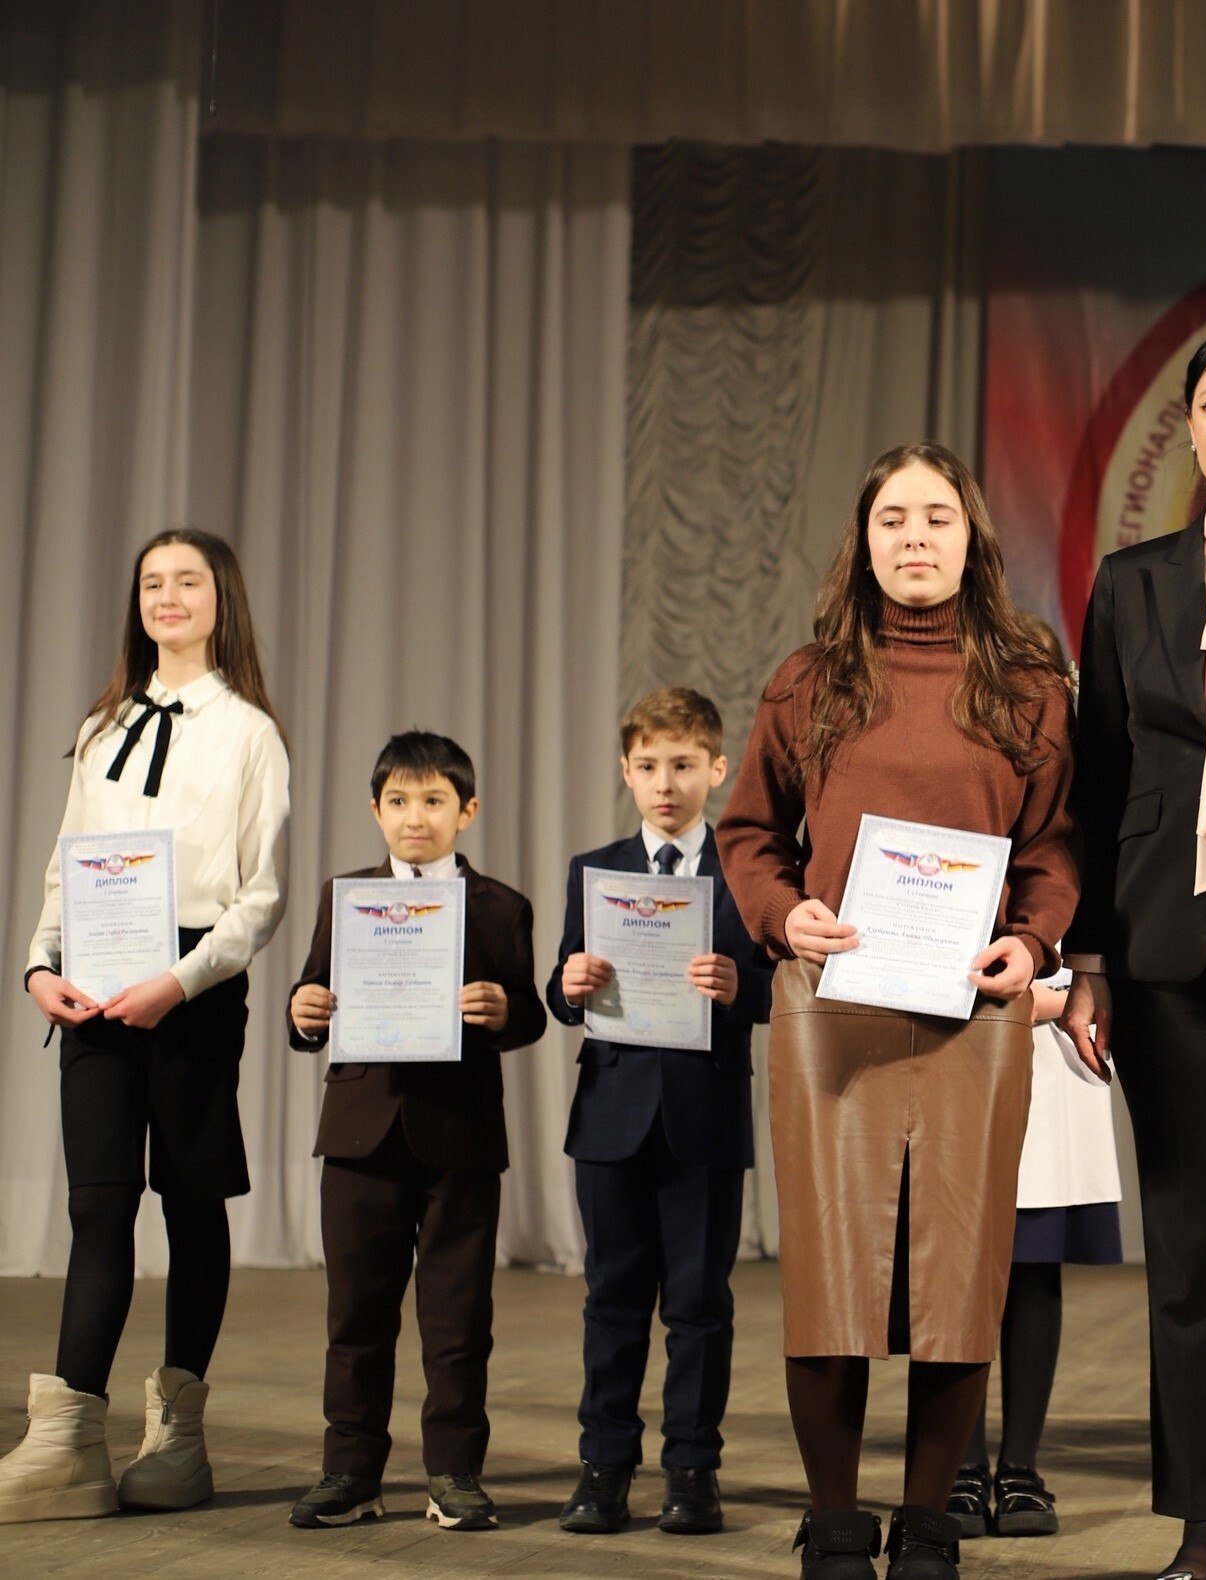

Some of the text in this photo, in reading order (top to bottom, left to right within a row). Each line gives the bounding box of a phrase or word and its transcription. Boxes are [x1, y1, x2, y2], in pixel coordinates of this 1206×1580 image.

[95, 876, 138, 888] ДИПЛОМ
[896, 874, 953, 891] ДИПЛОМ
[622, 917, 671, 929] ДИПЛОМ
[373, 926, 423, 937] ДИПЛОМ
